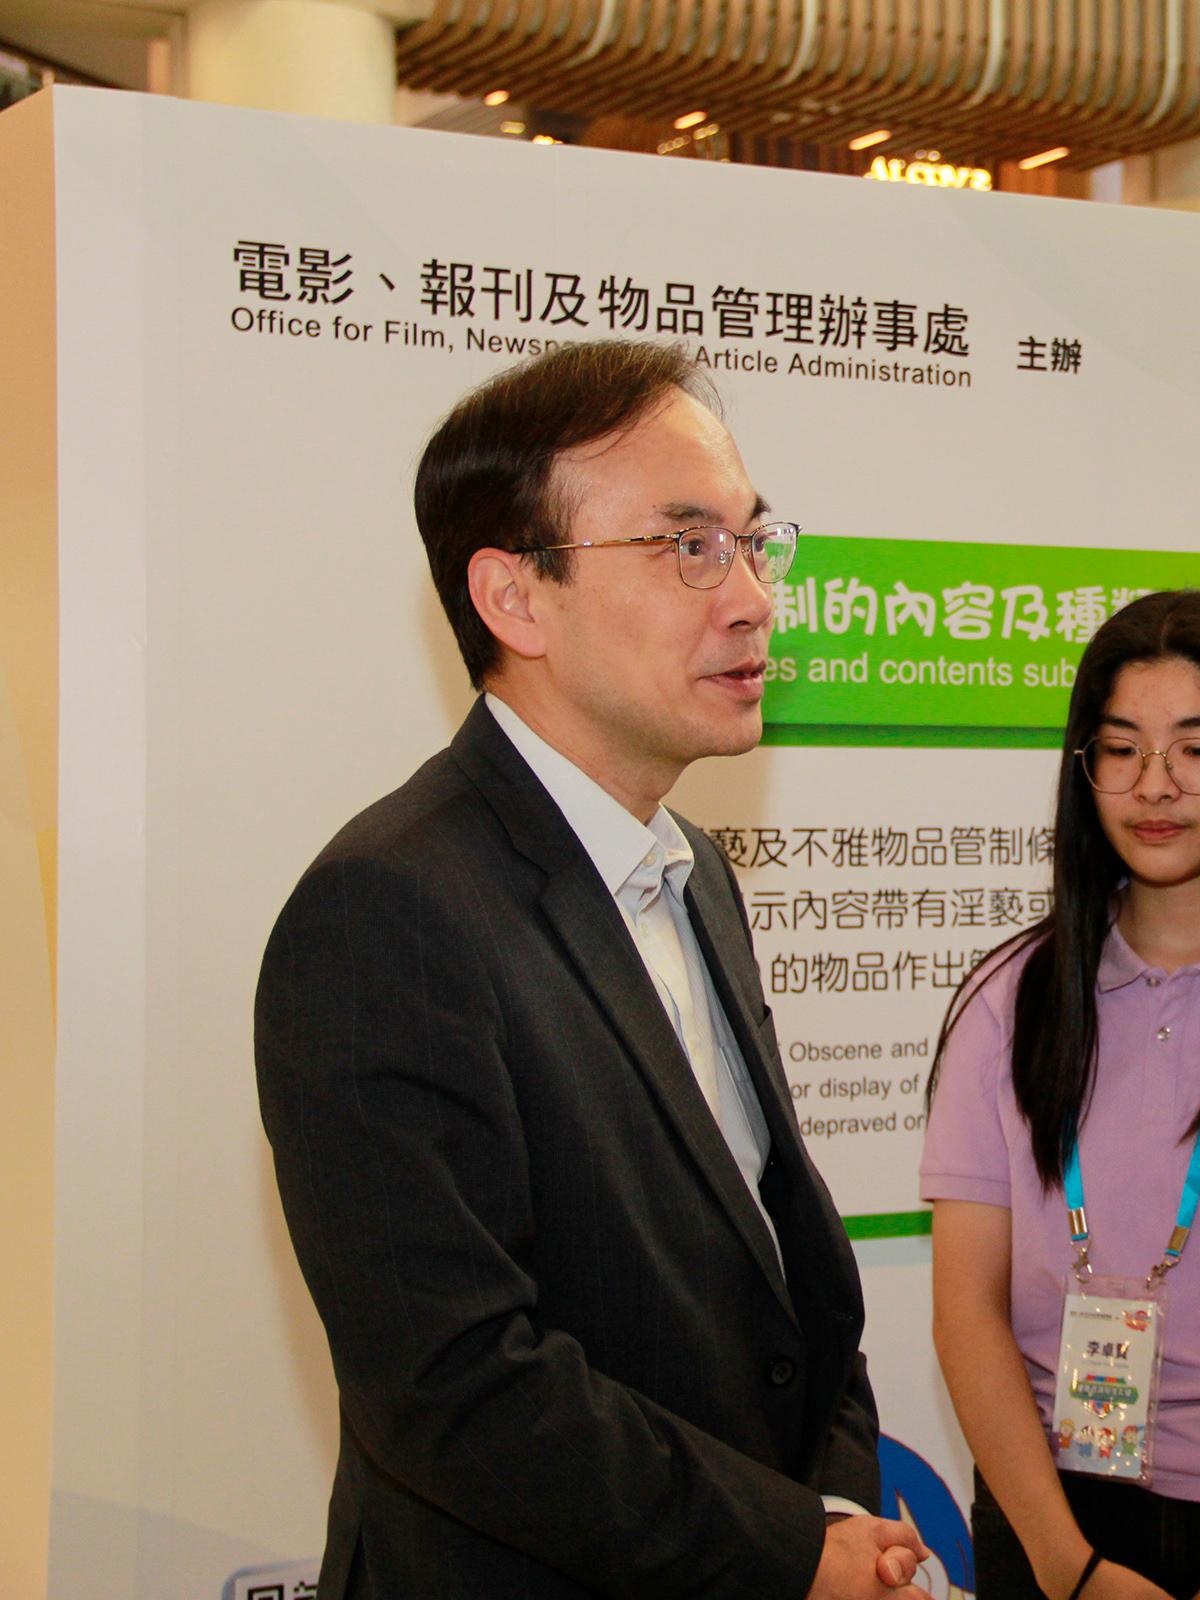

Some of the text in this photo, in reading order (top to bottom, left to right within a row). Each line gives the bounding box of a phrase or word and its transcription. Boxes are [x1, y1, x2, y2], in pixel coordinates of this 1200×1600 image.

[233, 239, 970, 358] 電影、報刊及物品管理辦事處
[230, 306, 322, 338] Office
[334, 314, 374, 343] for
[384, 319, 454, 354] Film,
[694, 345, 778, 373] Article
[787, 352, 972, 388] Administration
[1016, 335, 1083, 375] 主辦
[807, 651, 868, 683] and
[879, 654, 1014, 688] contents
[789, 1037, 929, 1063] Obscene and
[818, 1075, 892, 1102] display
[899, 1073, 920, 1095] of
[800, 1112, 897, 1140] depraved
